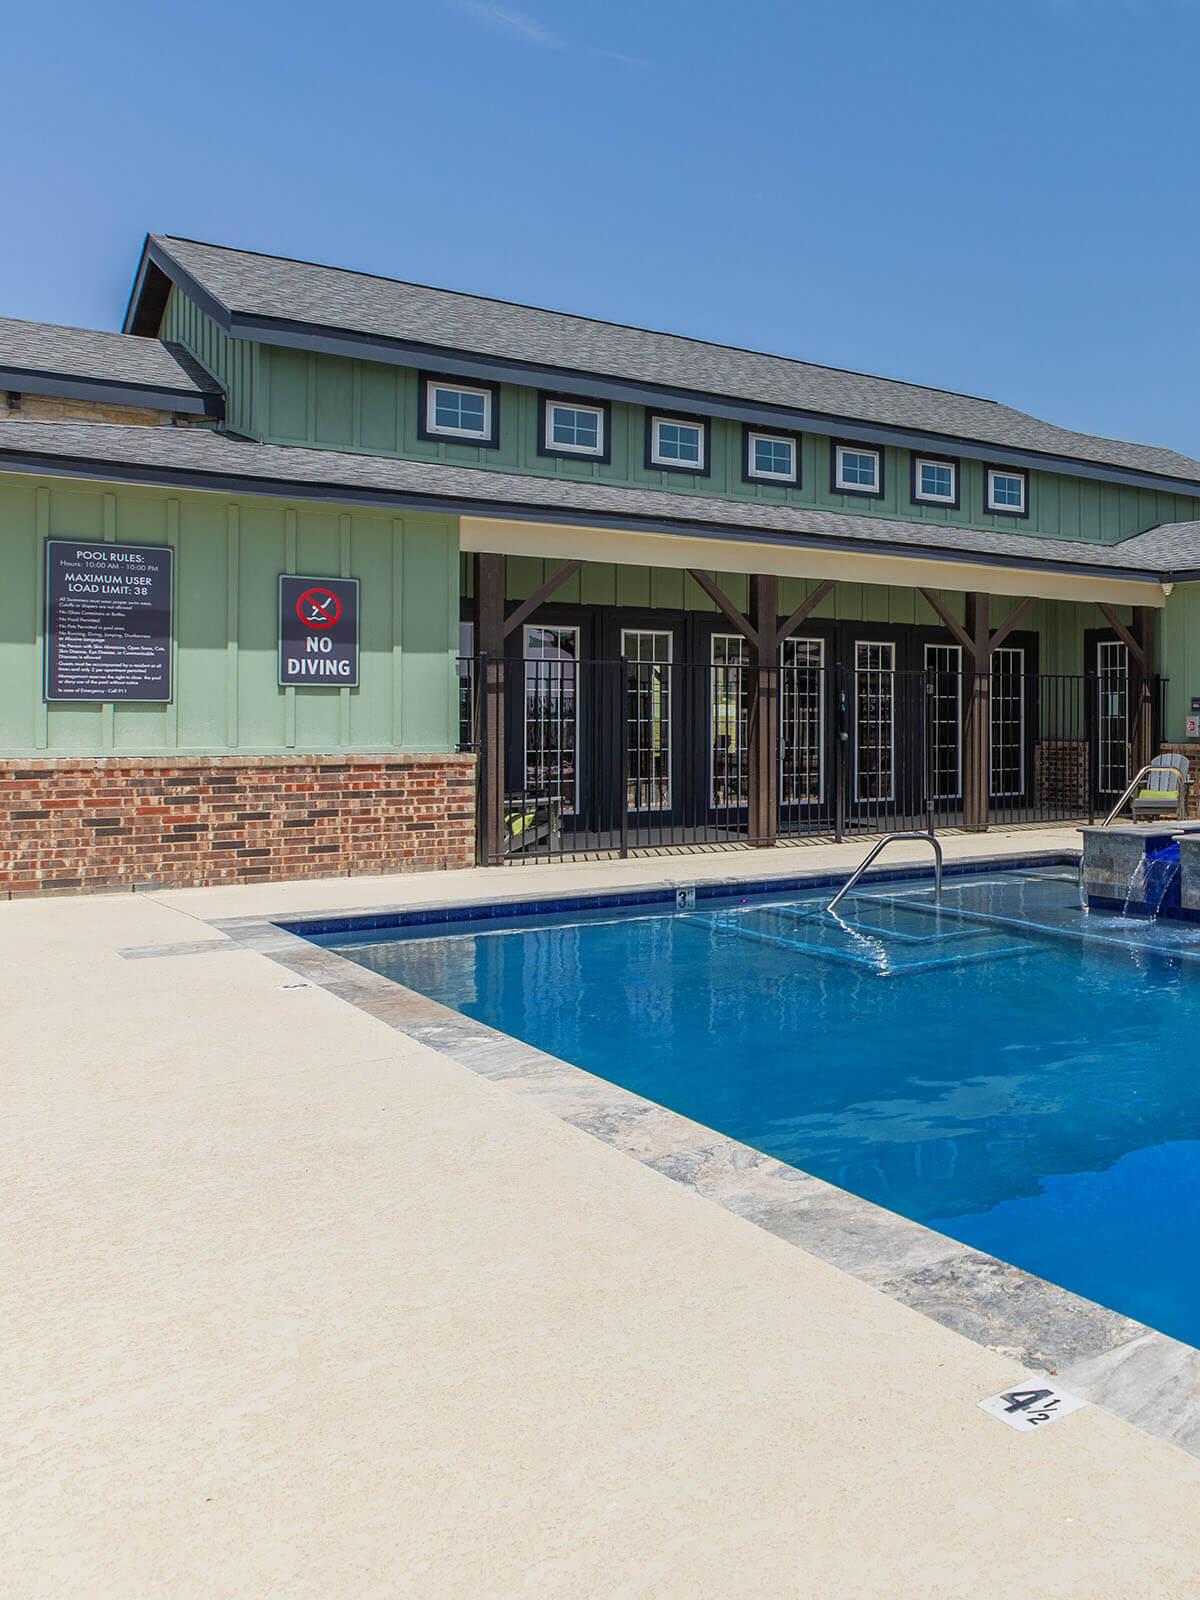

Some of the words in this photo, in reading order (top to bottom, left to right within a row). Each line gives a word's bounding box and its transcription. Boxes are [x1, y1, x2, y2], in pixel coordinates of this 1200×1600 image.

[77, 551, 107, 560] POOL
[110, 553, 144, 562] RULES:
[65, 574, 122, 584] MAXIMUM
[126, 577, 152, 585] USER
[69, 584, 99, 592] LOAD
[102, 586, 132, 594] LIMIT:
[306, 636, 332, 652] NO
[288, 658, 351, 675] DIVING
